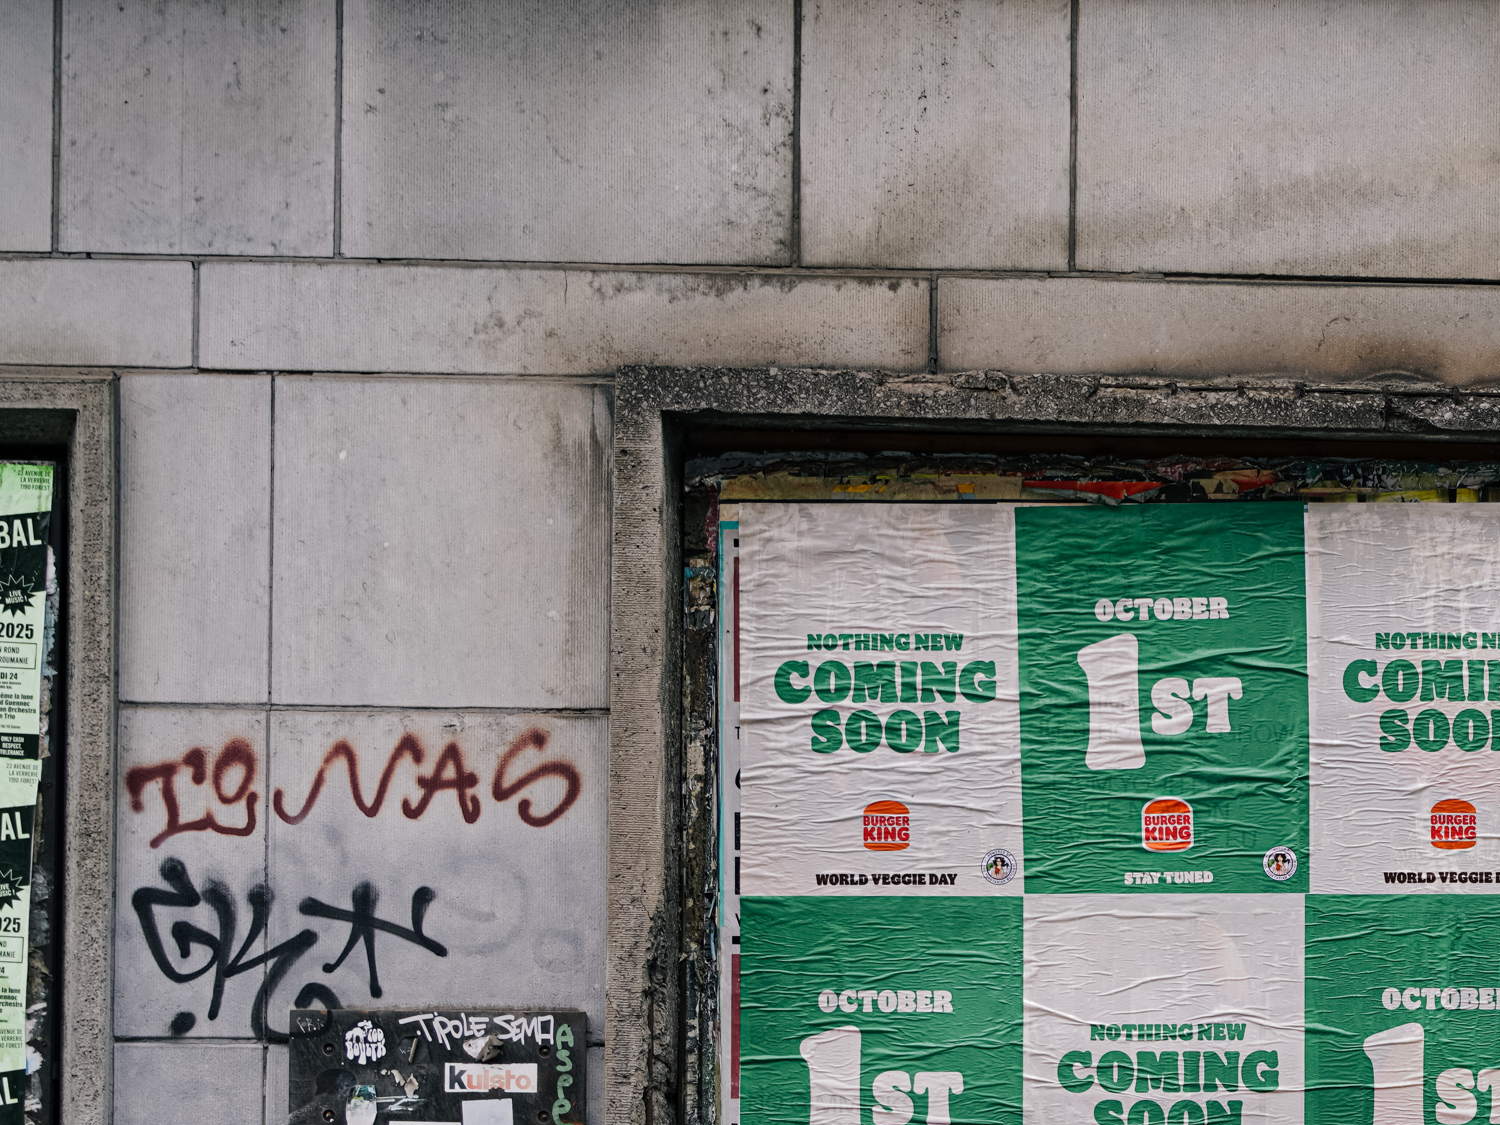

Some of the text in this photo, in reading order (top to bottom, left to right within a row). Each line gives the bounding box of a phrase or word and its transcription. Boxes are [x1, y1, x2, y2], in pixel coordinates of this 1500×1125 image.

[1095, 597, 1229, 622] OCTOBER
[807, 634, 963, 652] NOTHING NEW
[1376, 632, 1478, 650] NOTHING
[10, 672, 18, 680] 24
[775, 660, 997, 704] COMING
[811, 710, 961, 754] SOON
[863, 815, 910, 827] BURGER
[1144, 815, 1191, 827] BURGER
[1430, 814, 1476, 826] BURGER
[863, 826, 910, 843] KING
[1144, 826, 1191, 842] KING
[1430, 825, 1476, 841] KING
[816, 873, 958, 887] WORLD VEGGIE DAY
[1124, 871, 1213, 884] STAY TUNED
[1384, 872, 1435, 884] WORLD
[1439, 872, 1492, 885] VEGGIE
[818, 990, 954, 1014] OCTOBER
[1090, 1023, 1246, 1042] NOTHING NEW
[1057, 1050, 1279, 1093] COMING
